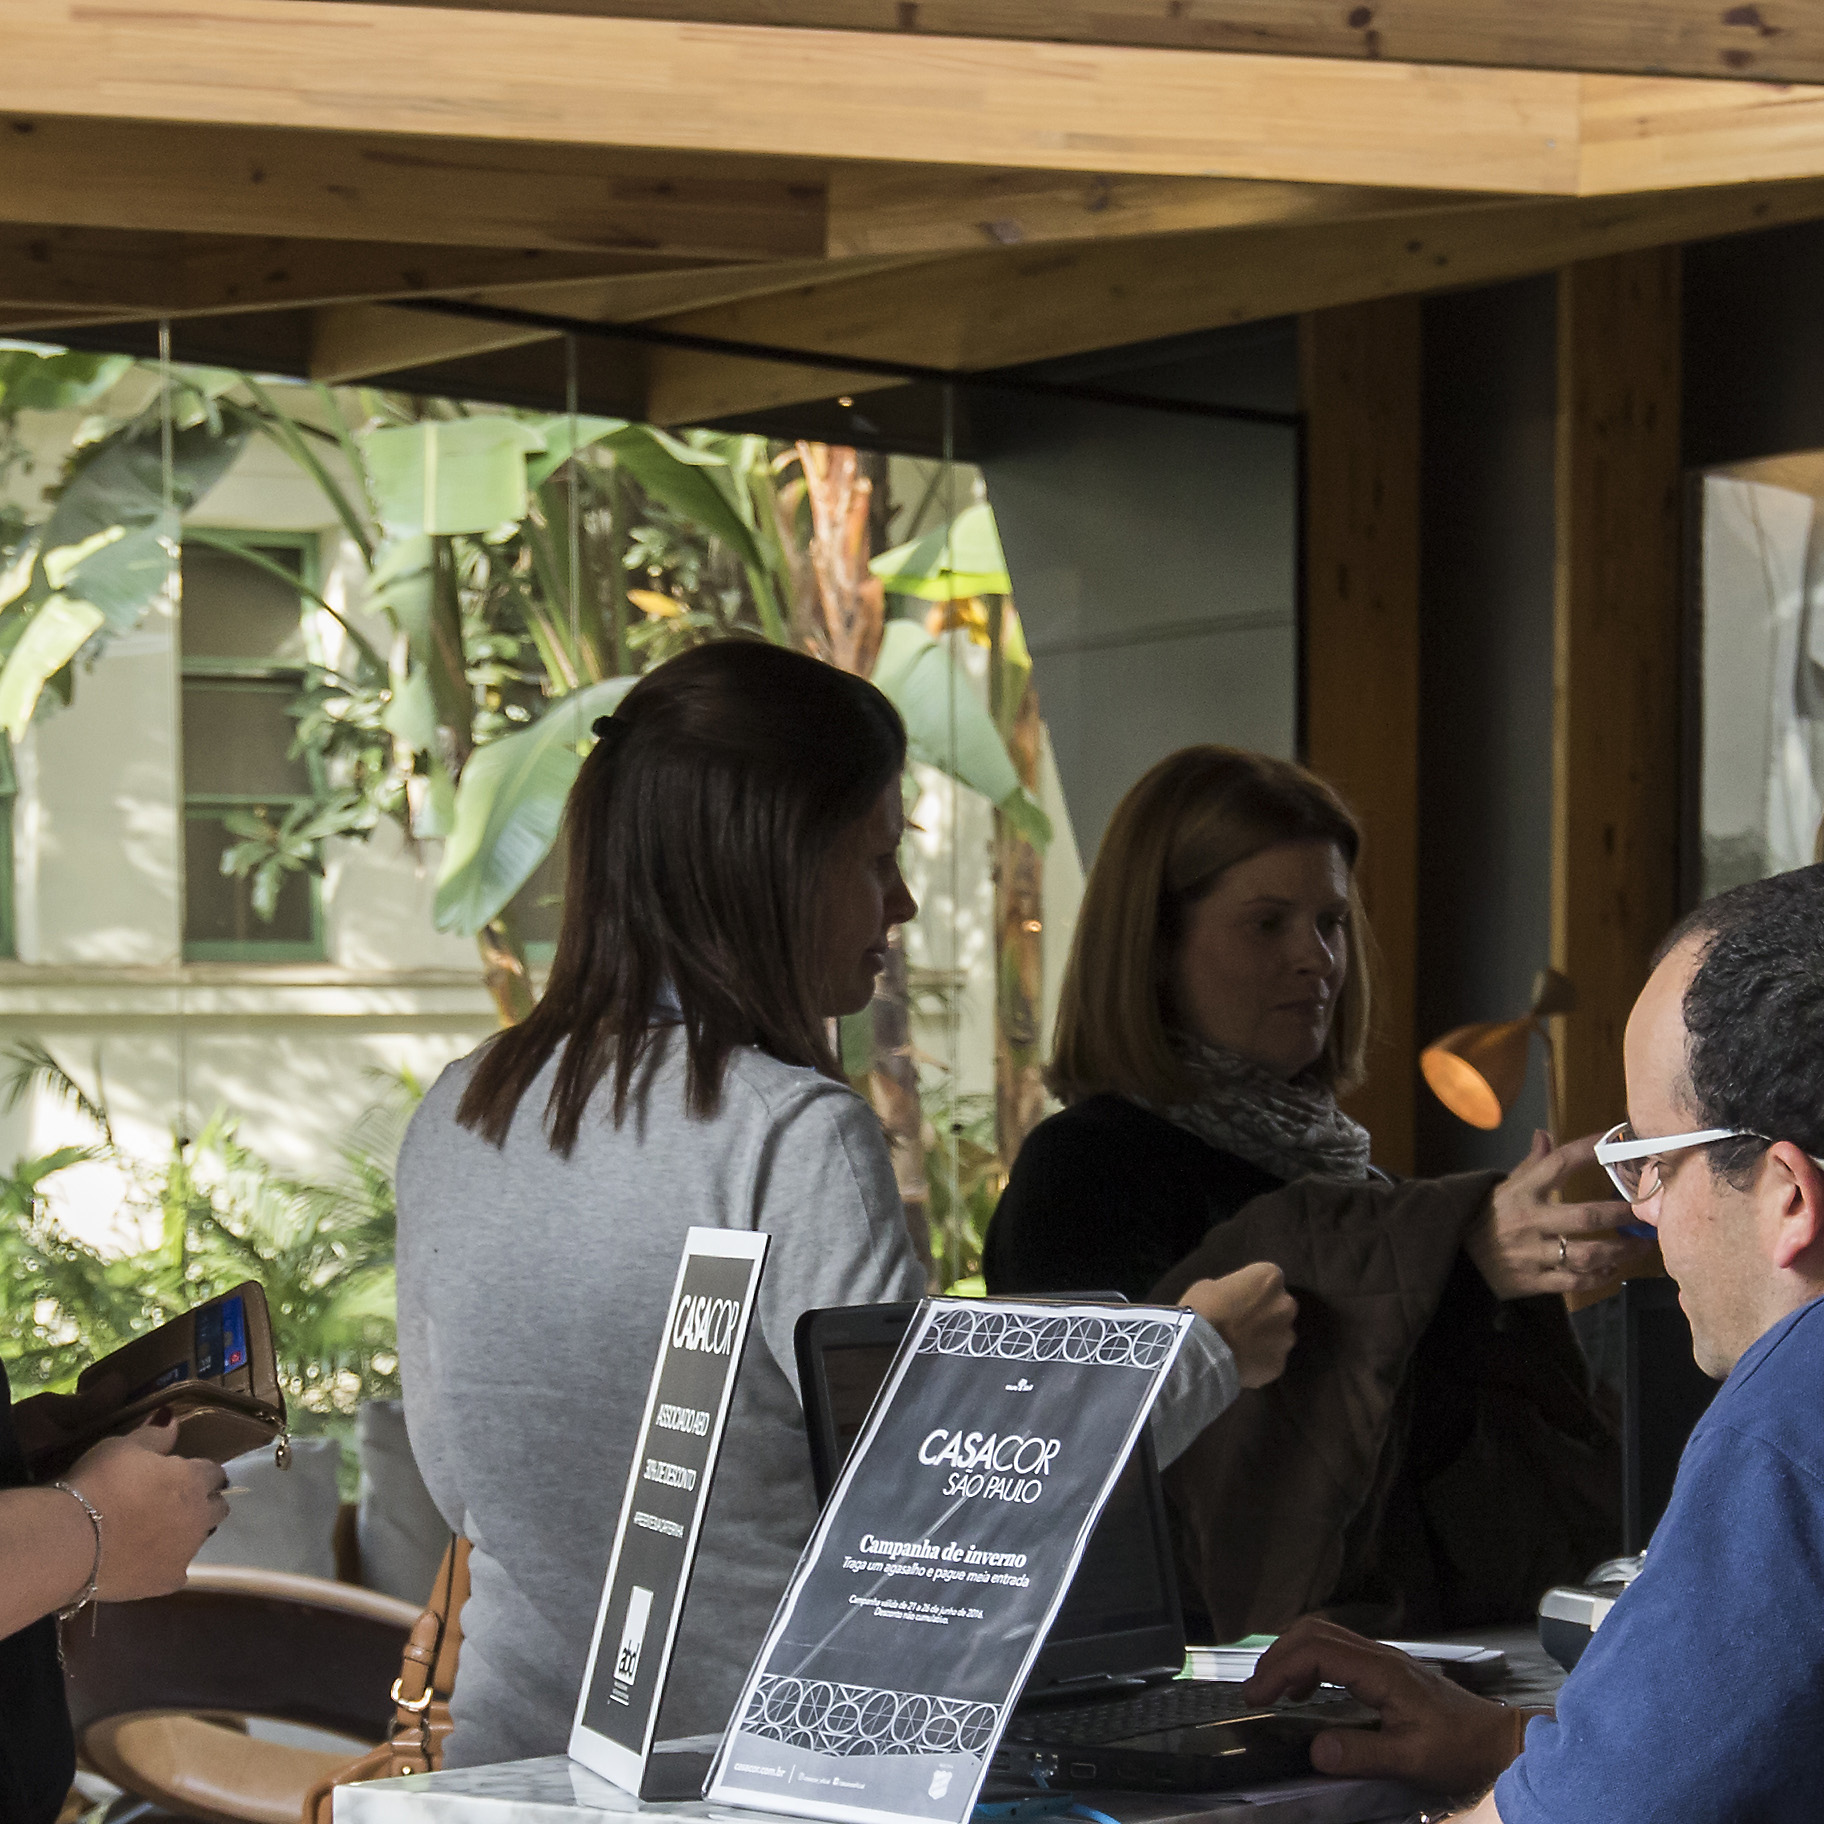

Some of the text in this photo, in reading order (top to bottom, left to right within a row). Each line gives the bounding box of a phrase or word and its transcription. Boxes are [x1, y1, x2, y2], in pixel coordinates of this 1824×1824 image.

[673, 1294, 739, 1355] CASACOR
[918, 1429, 1061, 1475] CASACOR
[942, 1468, 1042, 1504] SÃO PAULO
[860, 1534, 1027, 1568] Campanha de inverno
[842, 1556, 1030, 1588] Traga um agasalho e pague meia entrada
[618, 1639, 640, 1677] abd
